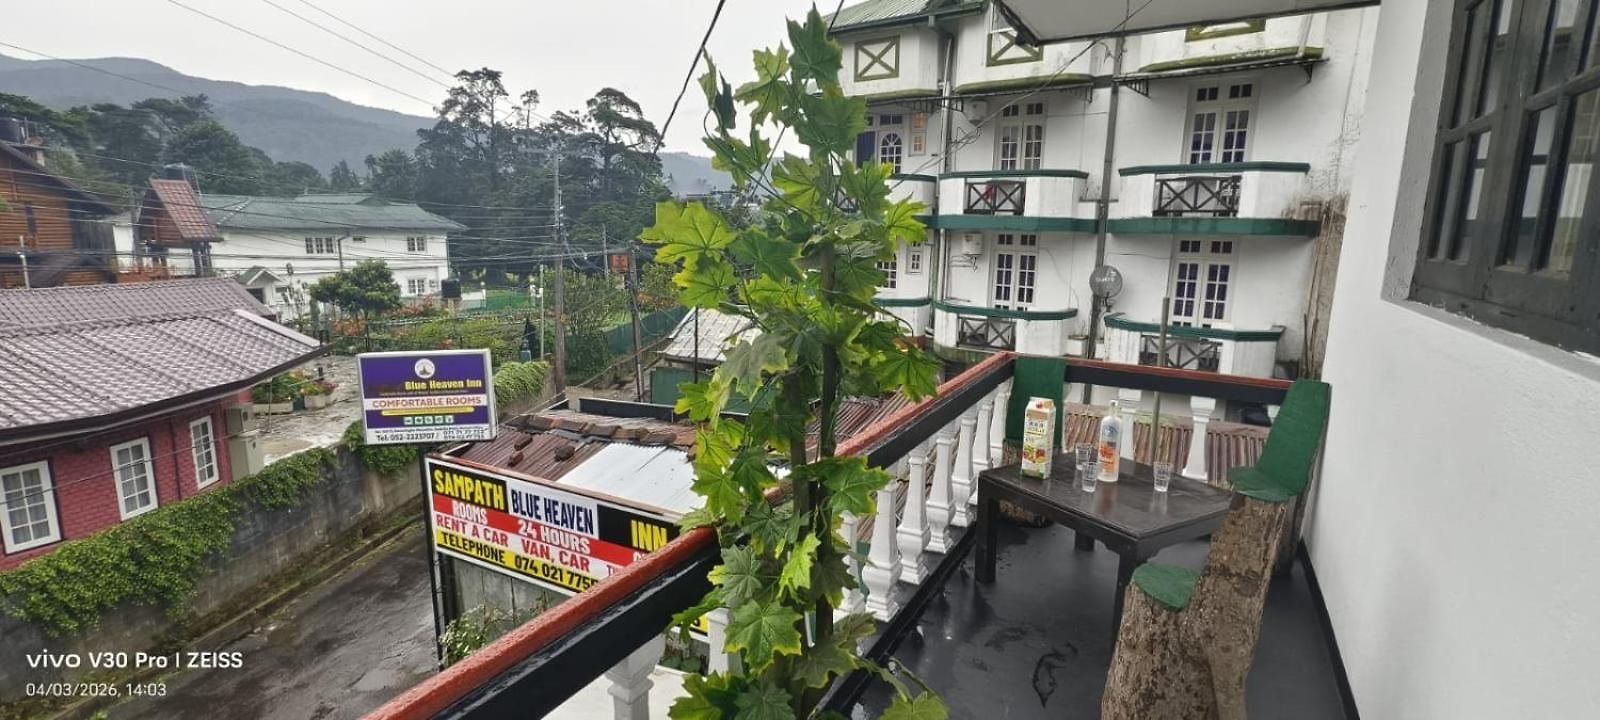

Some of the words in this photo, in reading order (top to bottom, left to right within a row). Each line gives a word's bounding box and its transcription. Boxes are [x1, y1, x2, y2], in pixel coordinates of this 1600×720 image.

[372, 398, 445, 408] COMFORTABLE
[446, 396, 481, 405] ROOMS
[404, 381, 427, 391] Blue
[429, 380, 464, 390] Heaven
[466, 378, 482, 388] Inn
[434, 469, 505, 511] SAMPATH
[511, 489, 541, 520] BLUE
[544, 499, 594, 536] HEAVEN
[631, 519, 667, 554] INN
[453, 500, 488, 525] ROOMS
[518, 520, 537, 538] 24
[541, 525, 590, 553] HOURS
[436, 514, 466, 534] RENT
[471, 522, 480, 539] A
[484, 526, 509, 547] CAR
[559, 551, 590, 572] CAR
[442, 532, 506, 563] TELEPHONE
[514, 554, 538, 574] 074
[542, 563, 563, 582] 021
